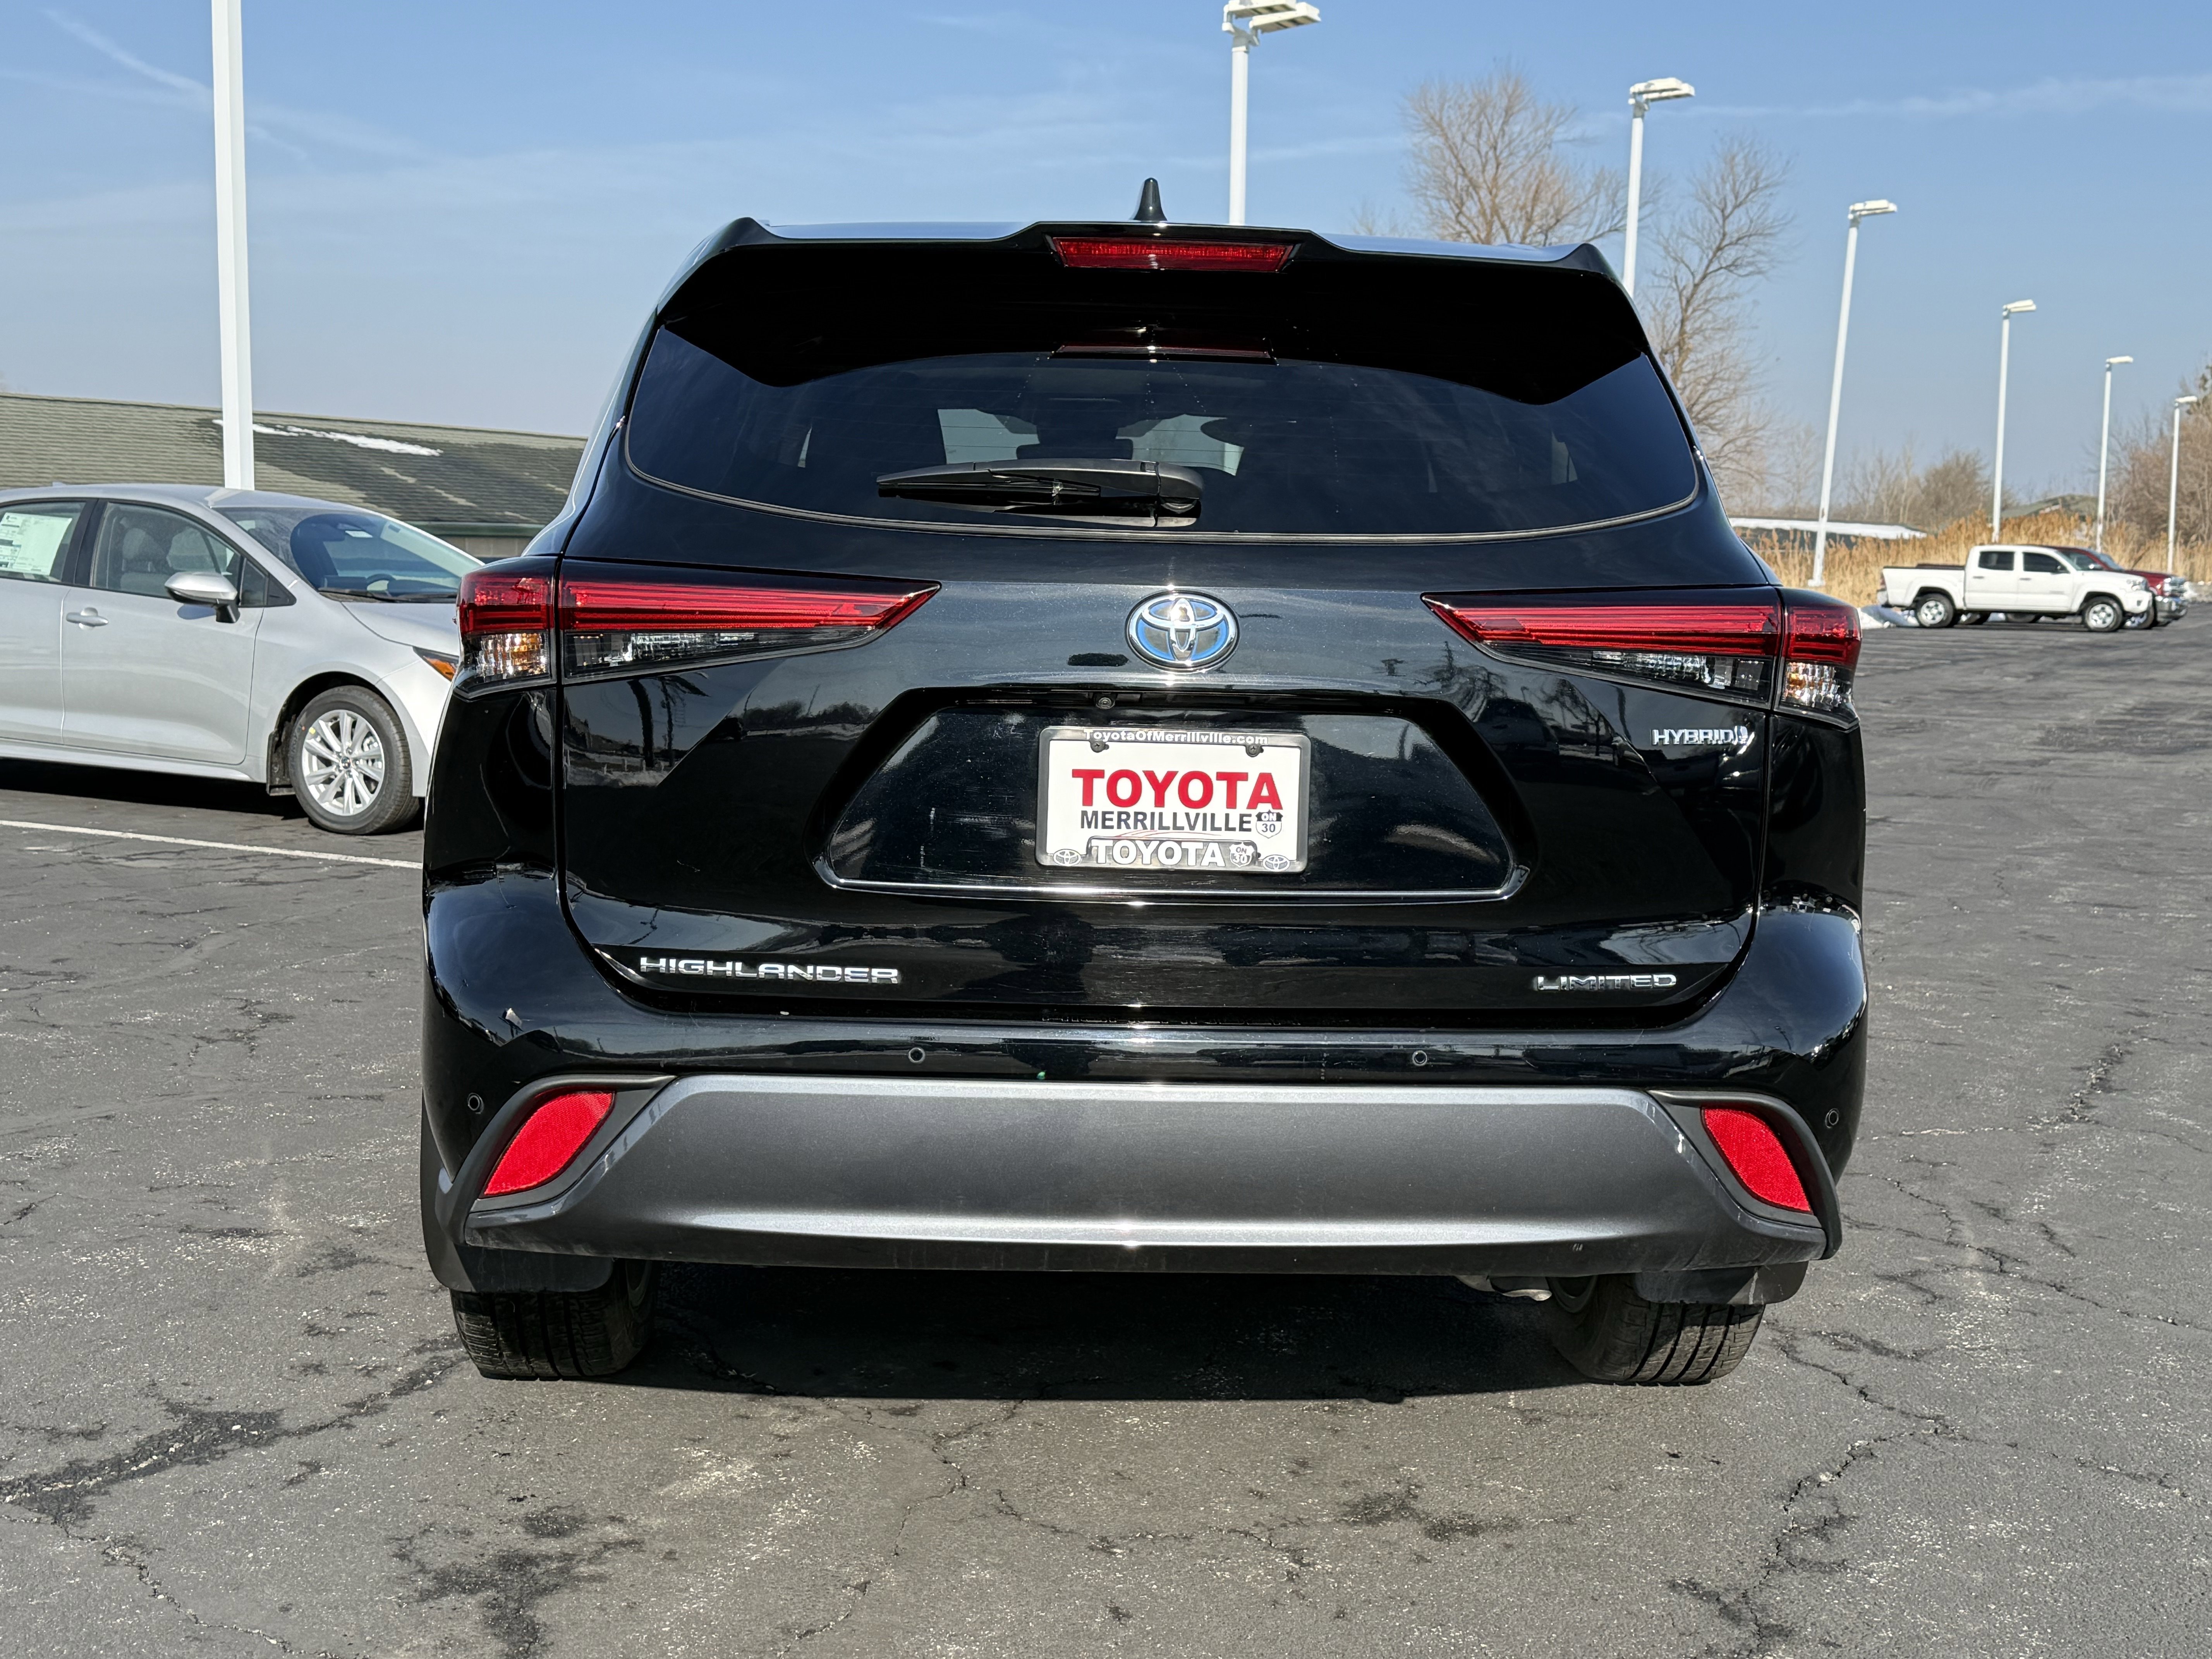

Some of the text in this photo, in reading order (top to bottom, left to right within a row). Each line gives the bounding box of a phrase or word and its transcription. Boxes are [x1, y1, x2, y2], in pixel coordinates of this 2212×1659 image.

[1084, 730, 1268, 745] ToyotaOfMerrillville.com
[1651, 729, 1736, 745] HYBRID
[1072, 769, 1283, 809] TOYOTA
[1081, 811, 1252, 832] MERRILLVILLE
[1261, 813, 1277, 821] ON
[1261, 823, 1276, 833] 30
[1091, 840, 1226, 867] TOYOTA
[1233, 854, 1247, 864] 30
[641, 957, 898, 984] HIGHLANDER
[1537, 974, 1676, 991] LIMITED
